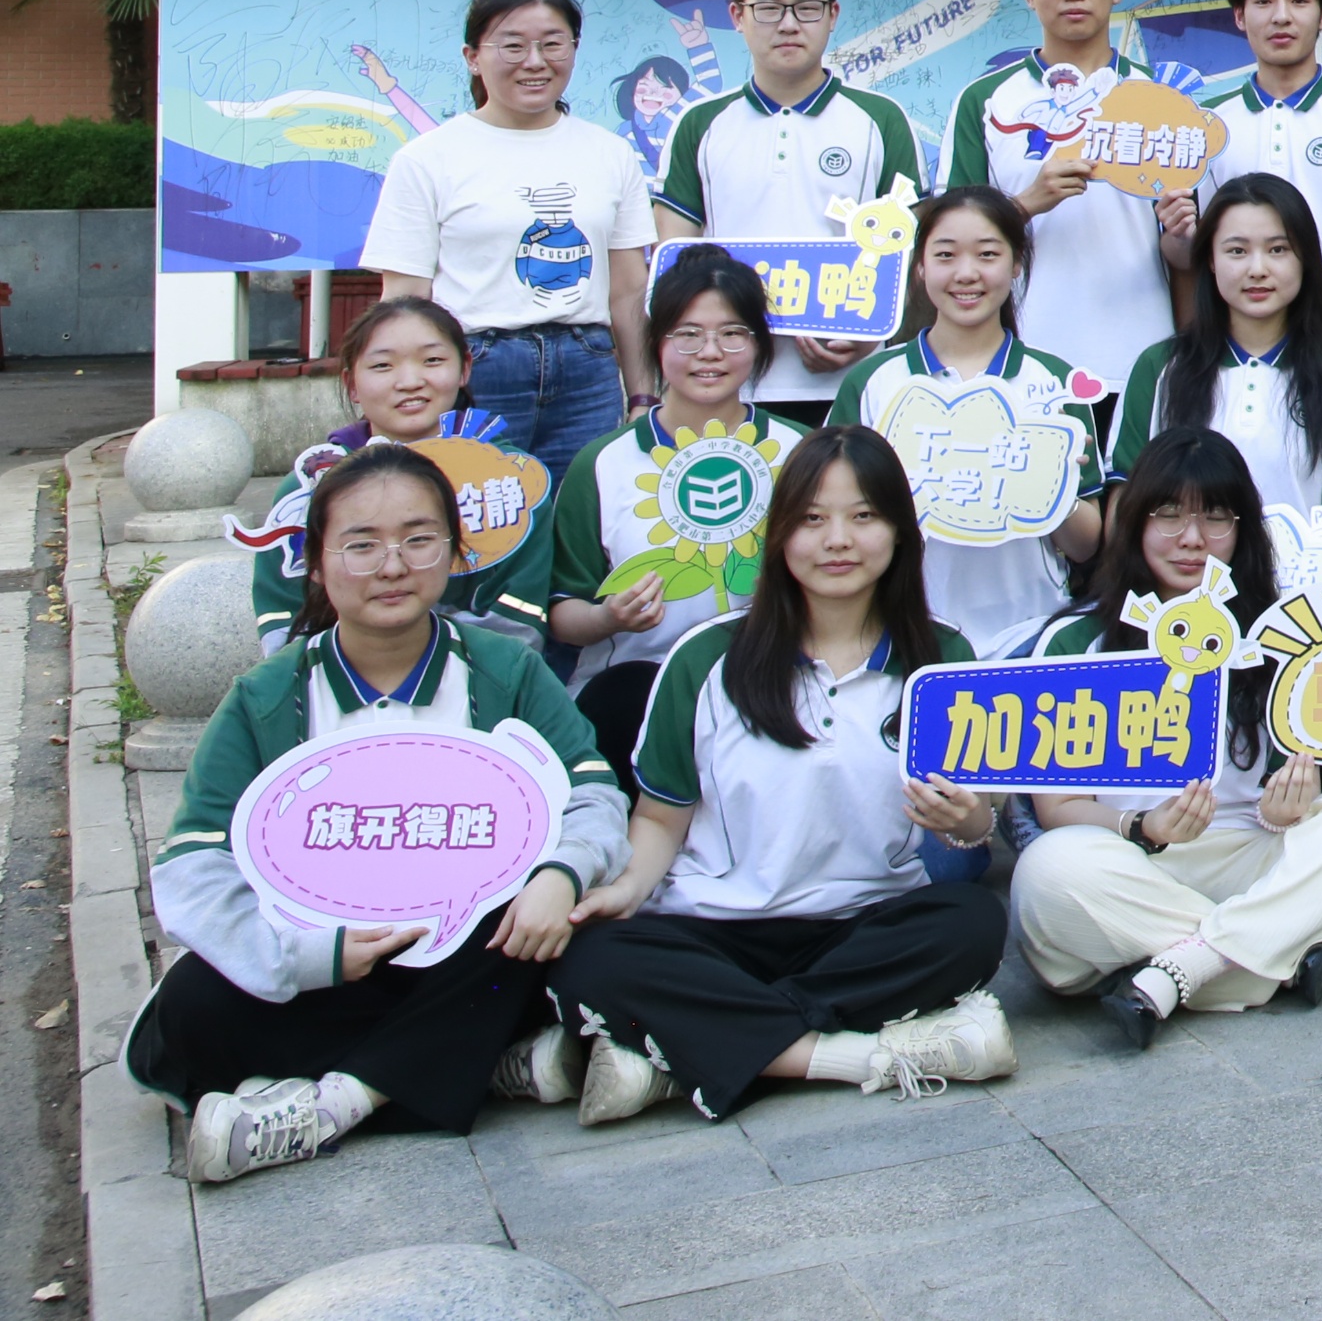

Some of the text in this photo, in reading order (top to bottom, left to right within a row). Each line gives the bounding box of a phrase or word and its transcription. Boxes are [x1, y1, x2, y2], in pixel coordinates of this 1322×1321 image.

[842, 44, 887, 82] FOR
[1080, 120, 1209, 169] 沉着冷静
[1026, 380, 1057, 399] PIU
[913, 422, 1032, 473] 下一站
[942, 688, 1191, 773] 加油鸭
[305, 802, 497, 850] 旗开得胜
